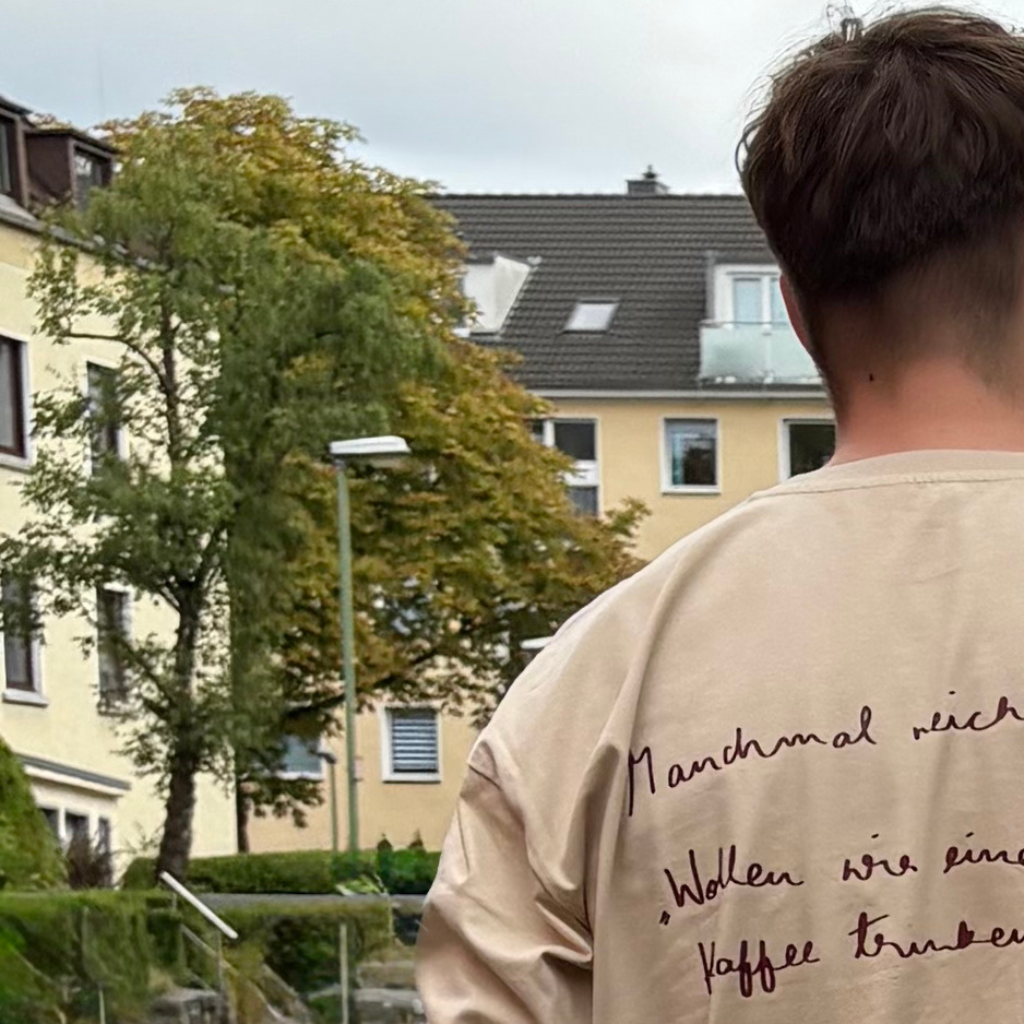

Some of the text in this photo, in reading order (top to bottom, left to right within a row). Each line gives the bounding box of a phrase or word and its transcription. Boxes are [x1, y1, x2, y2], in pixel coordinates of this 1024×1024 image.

[627, 705, 877, 817] Manchmal
[842, 833, 918, 881] wir
[698, 939, 820, 998] Kaffee
